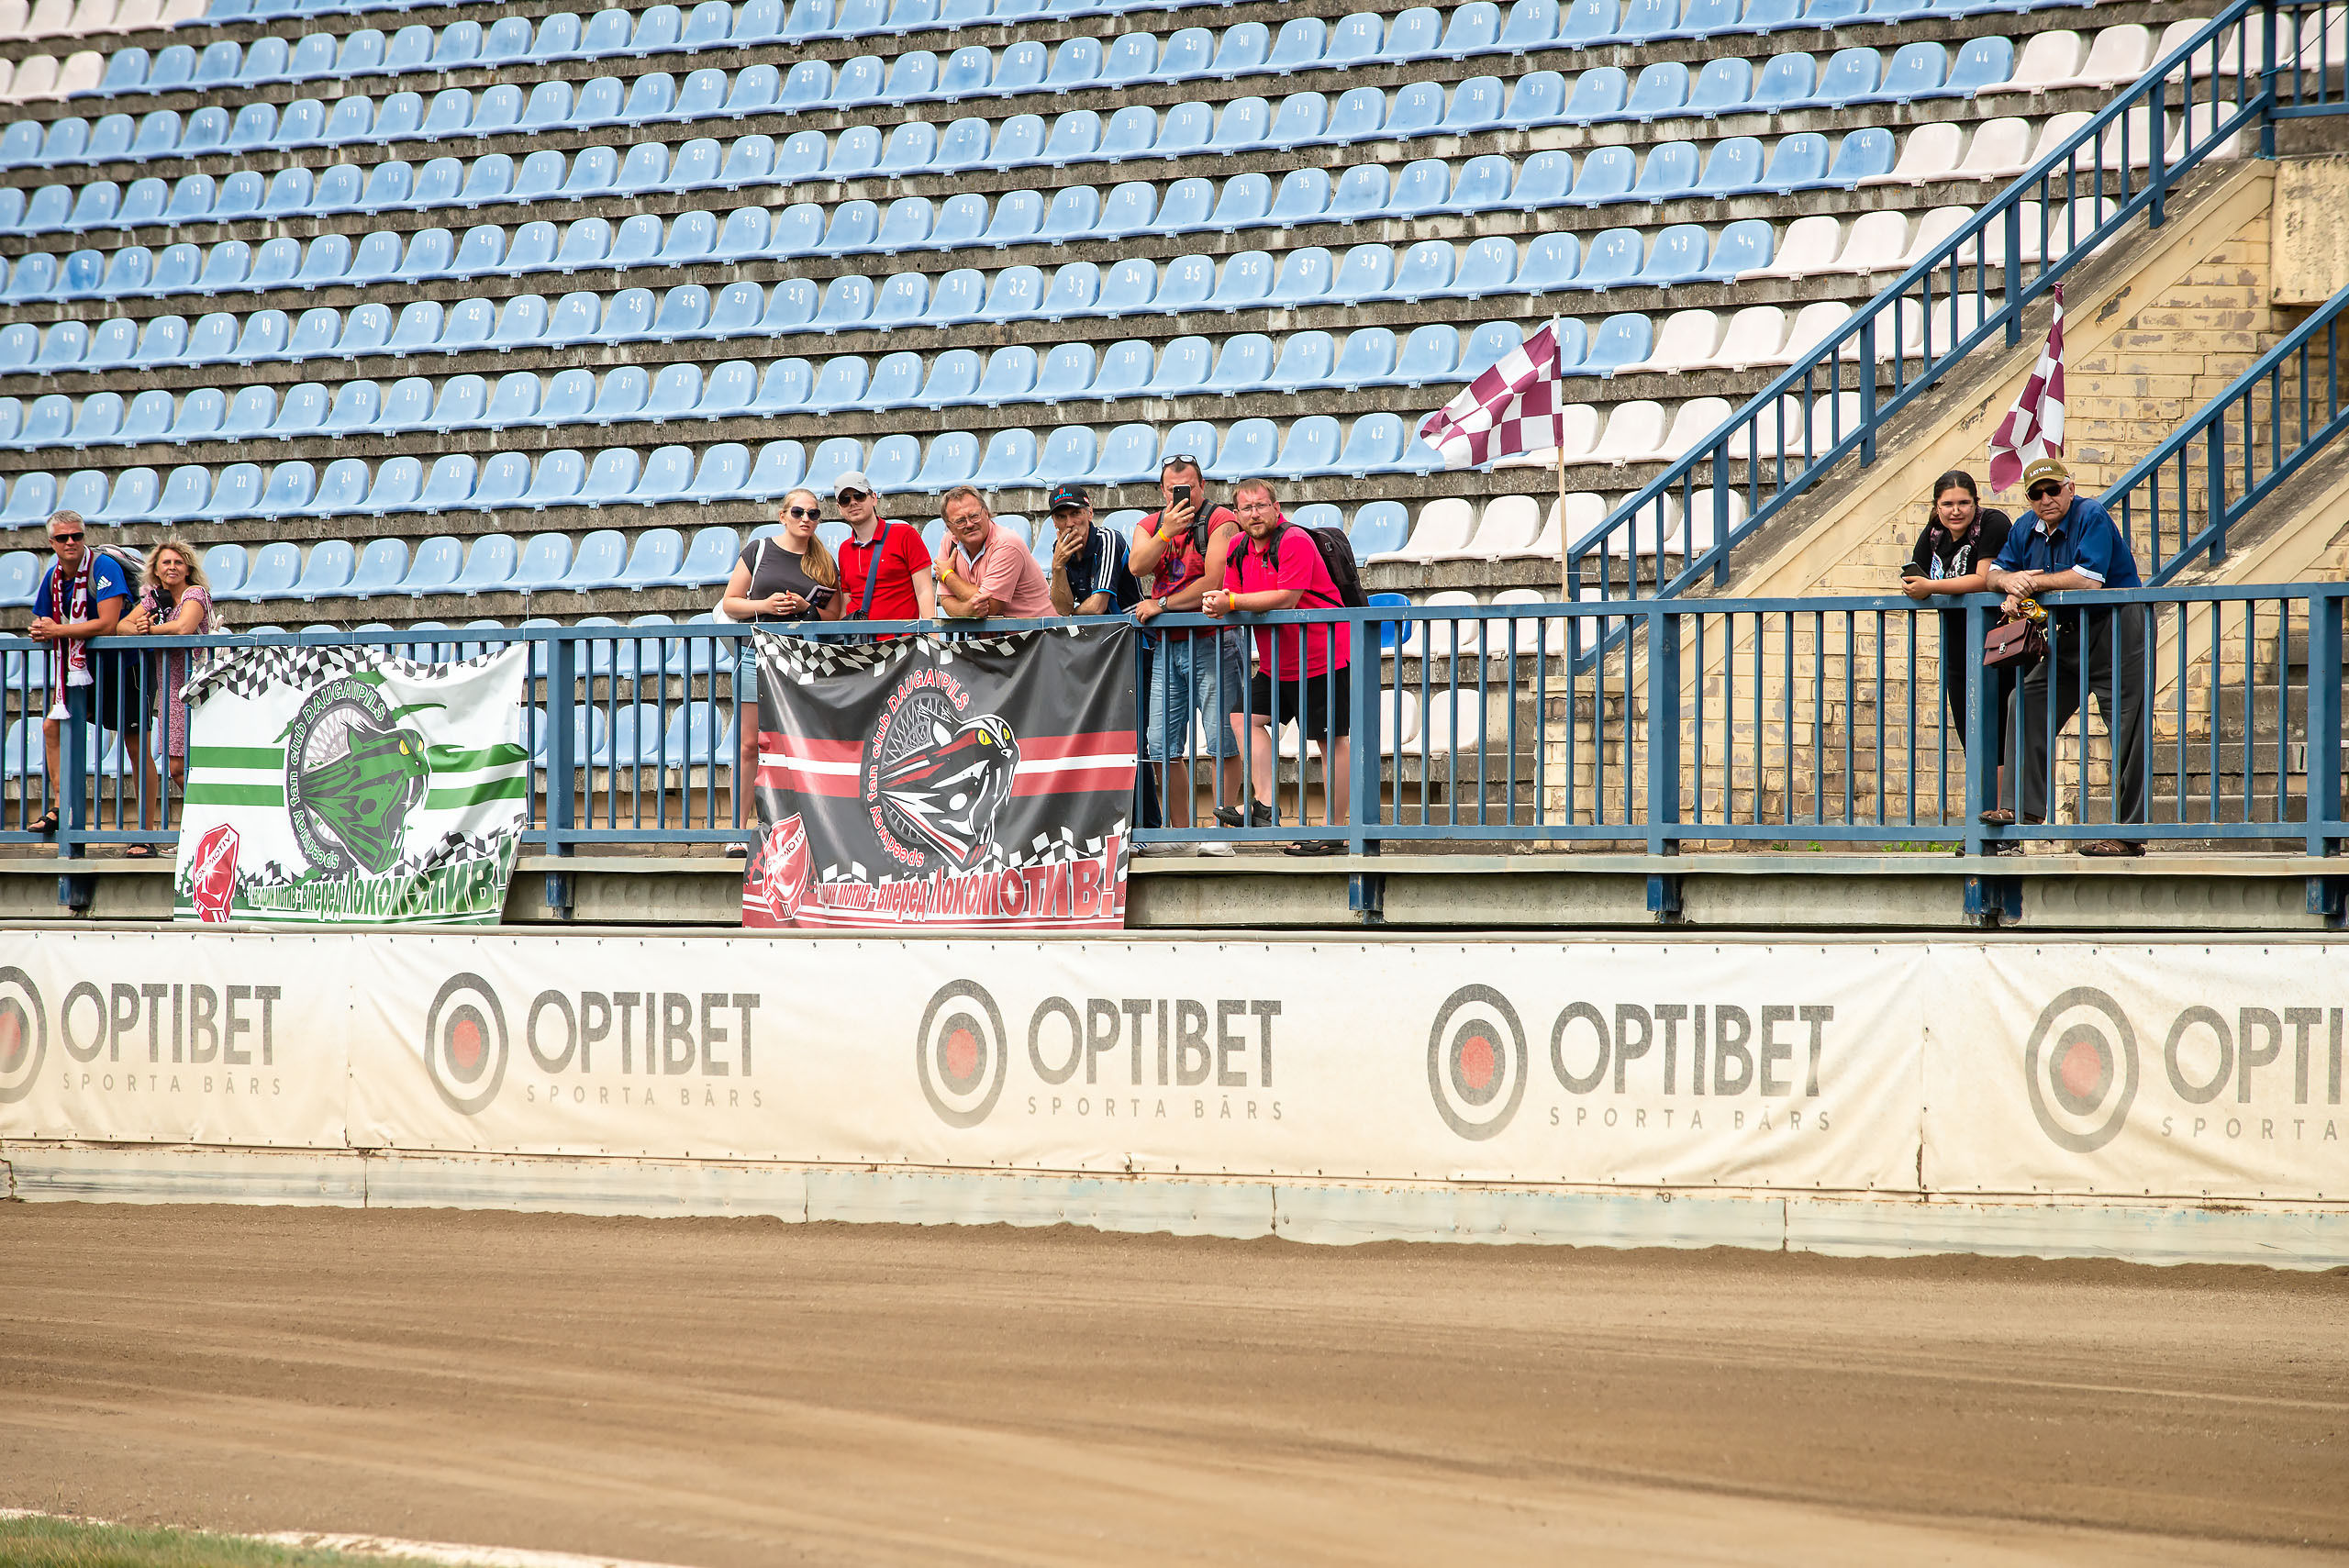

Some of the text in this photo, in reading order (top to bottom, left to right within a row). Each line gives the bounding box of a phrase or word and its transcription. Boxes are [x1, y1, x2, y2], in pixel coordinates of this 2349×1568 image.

[1527, 6, 1541, 19] 35
[1588, 2, 1600, 16] 36
[609, 17, 618, 30] 16
[1409, 17, 1421, 30] 33
[1473, 13, 1483, 26] 34
[1297, 28, 1308, 41] 31
[1353, 23, 1366, 37] 32
[1185, 37, 1197, 51] 29
[1239, 34, 1249, 47] 30
[1019, 50, 1032, 64] 26
[1073, 47, 1086, 60] 27
[1975, 50, 1988, 63] 44
[962, 55, 975, 68] 25
[1910, 57, 1923, 70] 43
[801, 69, 814, 83] 22
[1782, 63, 1793, 75] 41
[1472, 88, 1484, 101] 36
[1531, 83, 1544, 96] 37
[447, 98, 456, 111] 15
[496, 95, 507, 106] 16
[1353, 98, 1364, 111] 34
[1413, 94, 1426, 106] 35
[398, 102, 408, 113] 14
[1240, 106, 1251, 121] 32
[1181, 113, 1192, 126] 31
[1794, 141, 1808, 153] 43
[1861, 135, 1872, 149] 44
[693, 148, 706, 161] 22
[745, 144, 760, 158] 23
[1664, 150, 1675, 162] 41
[1728, 147, 1741, 161] 42
[338, 175, 348, 187] 15
[1298, 175, 1310, 189] 35
[1357, 171, 1370, 184] 36
[1416, 168, 1428, 183] 37
[1184, 186, 1197, 199] 33
[1240, 183, 1250, 196] 34
[1068, 195, 1079, 208] 31
[1125, 191, 1136, 206] 32
[852, 209, 863, 222] 27
[325, 242, 335, 254] 17
[1607, 239, 1625, 257] 42
[1671, 236, 1688, 251] 43
[1737, 235, 1754, 249] 44
[227, 245, 236, 258] 15
[274, 245, 285, 258] 16
[1419, 251, 1439, 266] 39
[1484, 243, 1503, 263] 40
[1546, 246, 1562, 260] 41
[1241, 261, 1258, 275] 36
[1298, 259, 1316, 275] 37
[1361, 254, 1377, 269] 38
[1125, 268, 1141, 284] 34
[1184, 265, 1201, 281] 35
[896, 283, 913, 295] 30
[952, 279, 967, 295] 31
[1008, 277, 1029, 295] 32
[1068, 275, 1084, 297] 33
[682, 295, 696, 307] 26
[734, 292, 748, 304] 27
[788, 287, 804, 304] 28
[842, 285, 860, 304] 29
[518, 304, 529, 316] 23
[572, 301, 586, 316] 24
[629, 296, 643, 312] 25
[362, 313, 377, 328] 20
[415, 311, 429, 323] 21
[468, 308, 481, 320] 22
[162, 326, 174, 339] 16
[213, 320, 226, 334] 17
[262, 317, 272, 335] 18
[314, 318, 328, 333] 19
[114, 328, 125, 339] 15
[1618, 327, 1631, 339] 44
[1429, 339, 1440, 351] 41
[1184, 349, 1196, 361] 37
[839, 370, 852, 383] 31
[568, 381, 581, 395] 26
[303, 394, 314, 406] 21
[354, 392, 367, 405] 22
[1308, 429, 1319, 443] 41
[1371, 425, 1384, 440] 42
[947, 443, 960, 457] 35
[1006, 442, 1016, 456] 36
[1066, 437, 1078, 452] 37
[775, 453, 788, 466] 32
[890, 450, 901, 462] 34
[449, 464, 461, 478] 26
[503, 463, 515, 478] 27
[722, 459, 733, 472] 31
[186, 476, 198, 491] 21
[236, 474, 248, 488] 22
[287, 473, 298, 487] 23
[341, 469, 351, 484] 24
[289, 681, 387, 868] speedway fan club DAUGAVPILS
[867, 668, 970, 867] speedway fan club DAUGAVPILS
[876, 881, 927, 920] вперед
[61, 982, 281, 1065] OPTIBET
[527, 989, 761, 1077] OPTIBET
[1028, 995, 1282, 1087] OPTIBET
[1551, 1001, 1834, 1096] OPTIBET
[2165, 1005, 2343, 1105] OPTI
[63, 1072, 281, 1095] SPORTA BĀRS
[527, 1084, 763, 1108] SPORTA BĀRS
[1028, 1095, 1282, 1120] SPORTA BĀRS
[1551, 1106, 1830, 1131] SPORTA BĀRS
[2161, 1116, 2338, 1140] SPORTA
